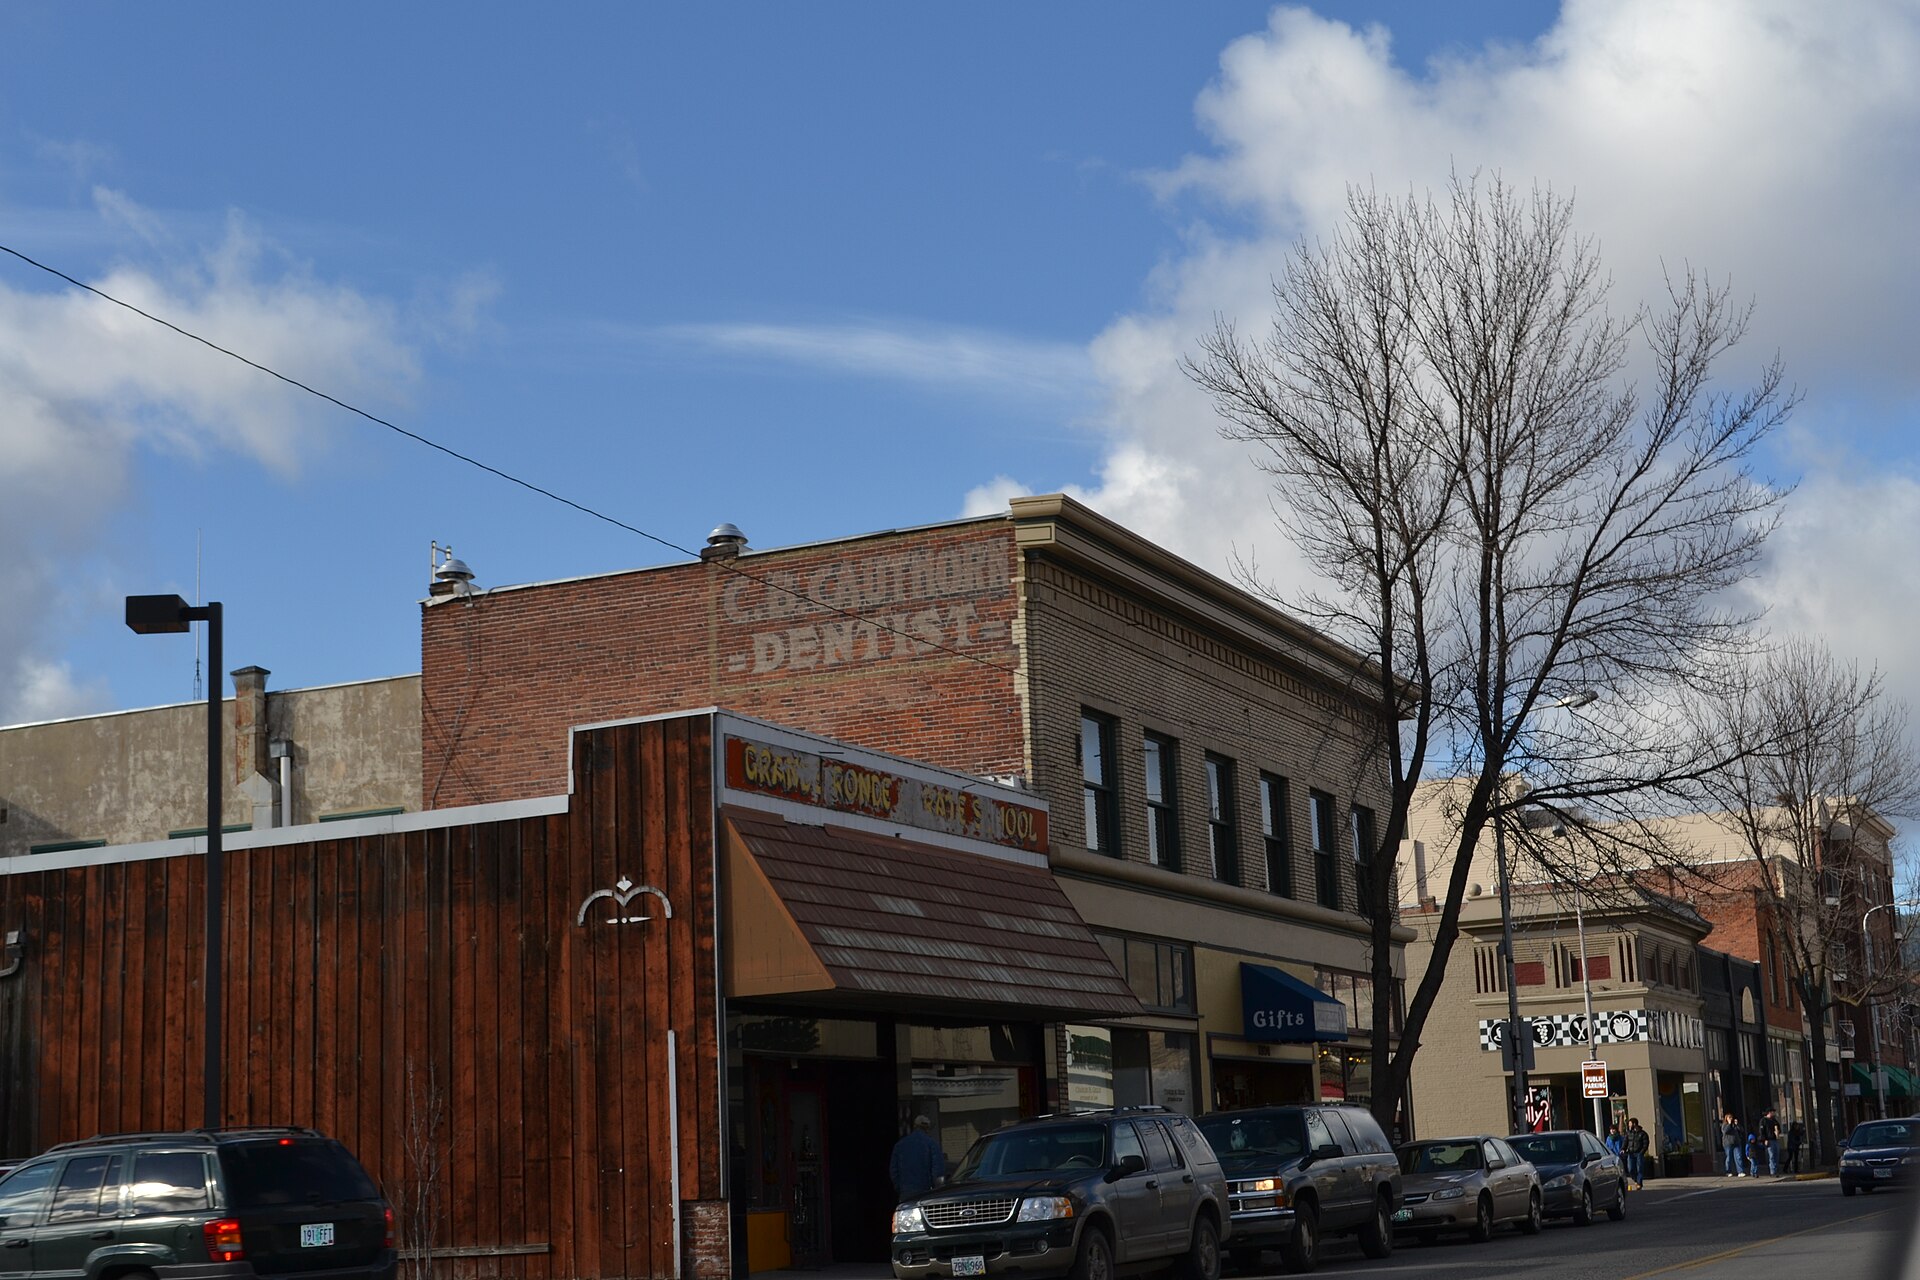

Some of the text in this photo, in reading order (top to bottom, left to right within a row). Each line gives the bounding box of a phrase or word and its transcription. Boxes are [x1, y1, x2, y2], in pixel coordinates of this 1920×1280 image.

[832, 765, 893, 813] RONDE
[1253, 1010, 1305, 1030] Gifts
[1585, 1075, 1604, 1083] PUBLIC
